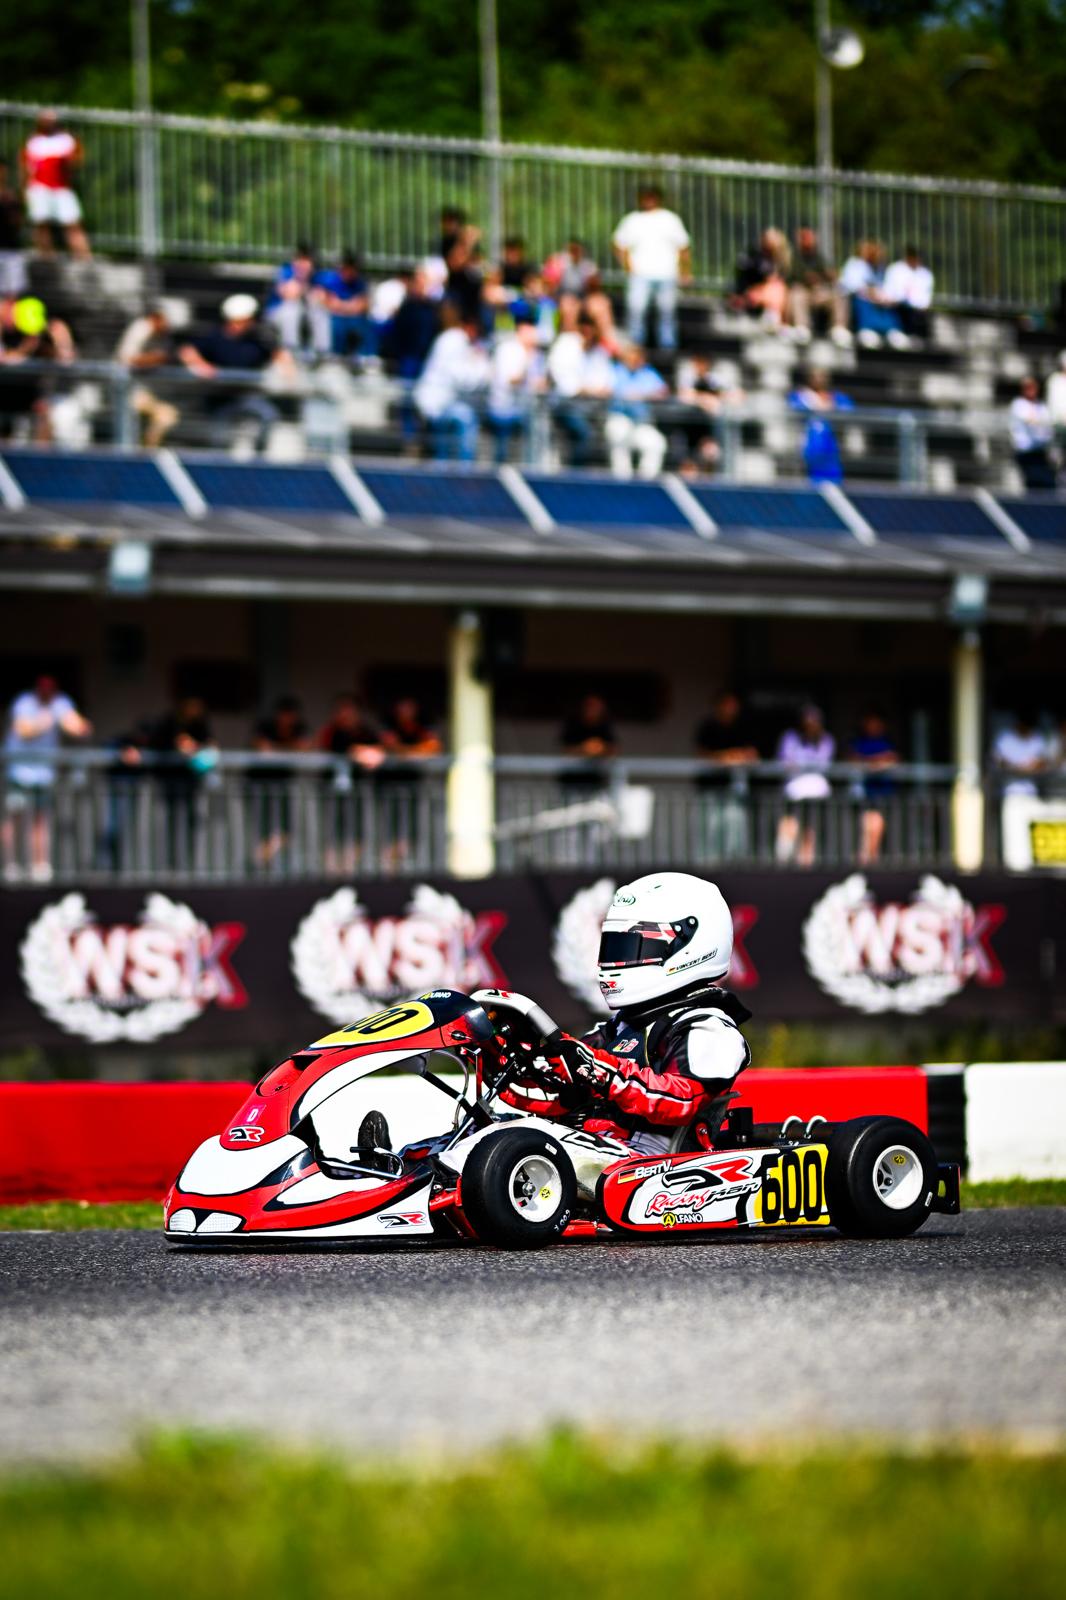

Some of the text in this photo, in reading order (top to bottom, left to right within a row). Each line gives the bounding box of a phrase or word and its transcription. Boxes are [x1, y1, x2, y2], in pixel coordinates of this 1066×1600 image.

[58, 921, 248, 1009] WSK
[324, 910, 510, 992] WSK
[836, 903, 1007, 988] WSK
[647, 1189, 711, 1214] Racing
[759, 1150, 824, 1224] 600
